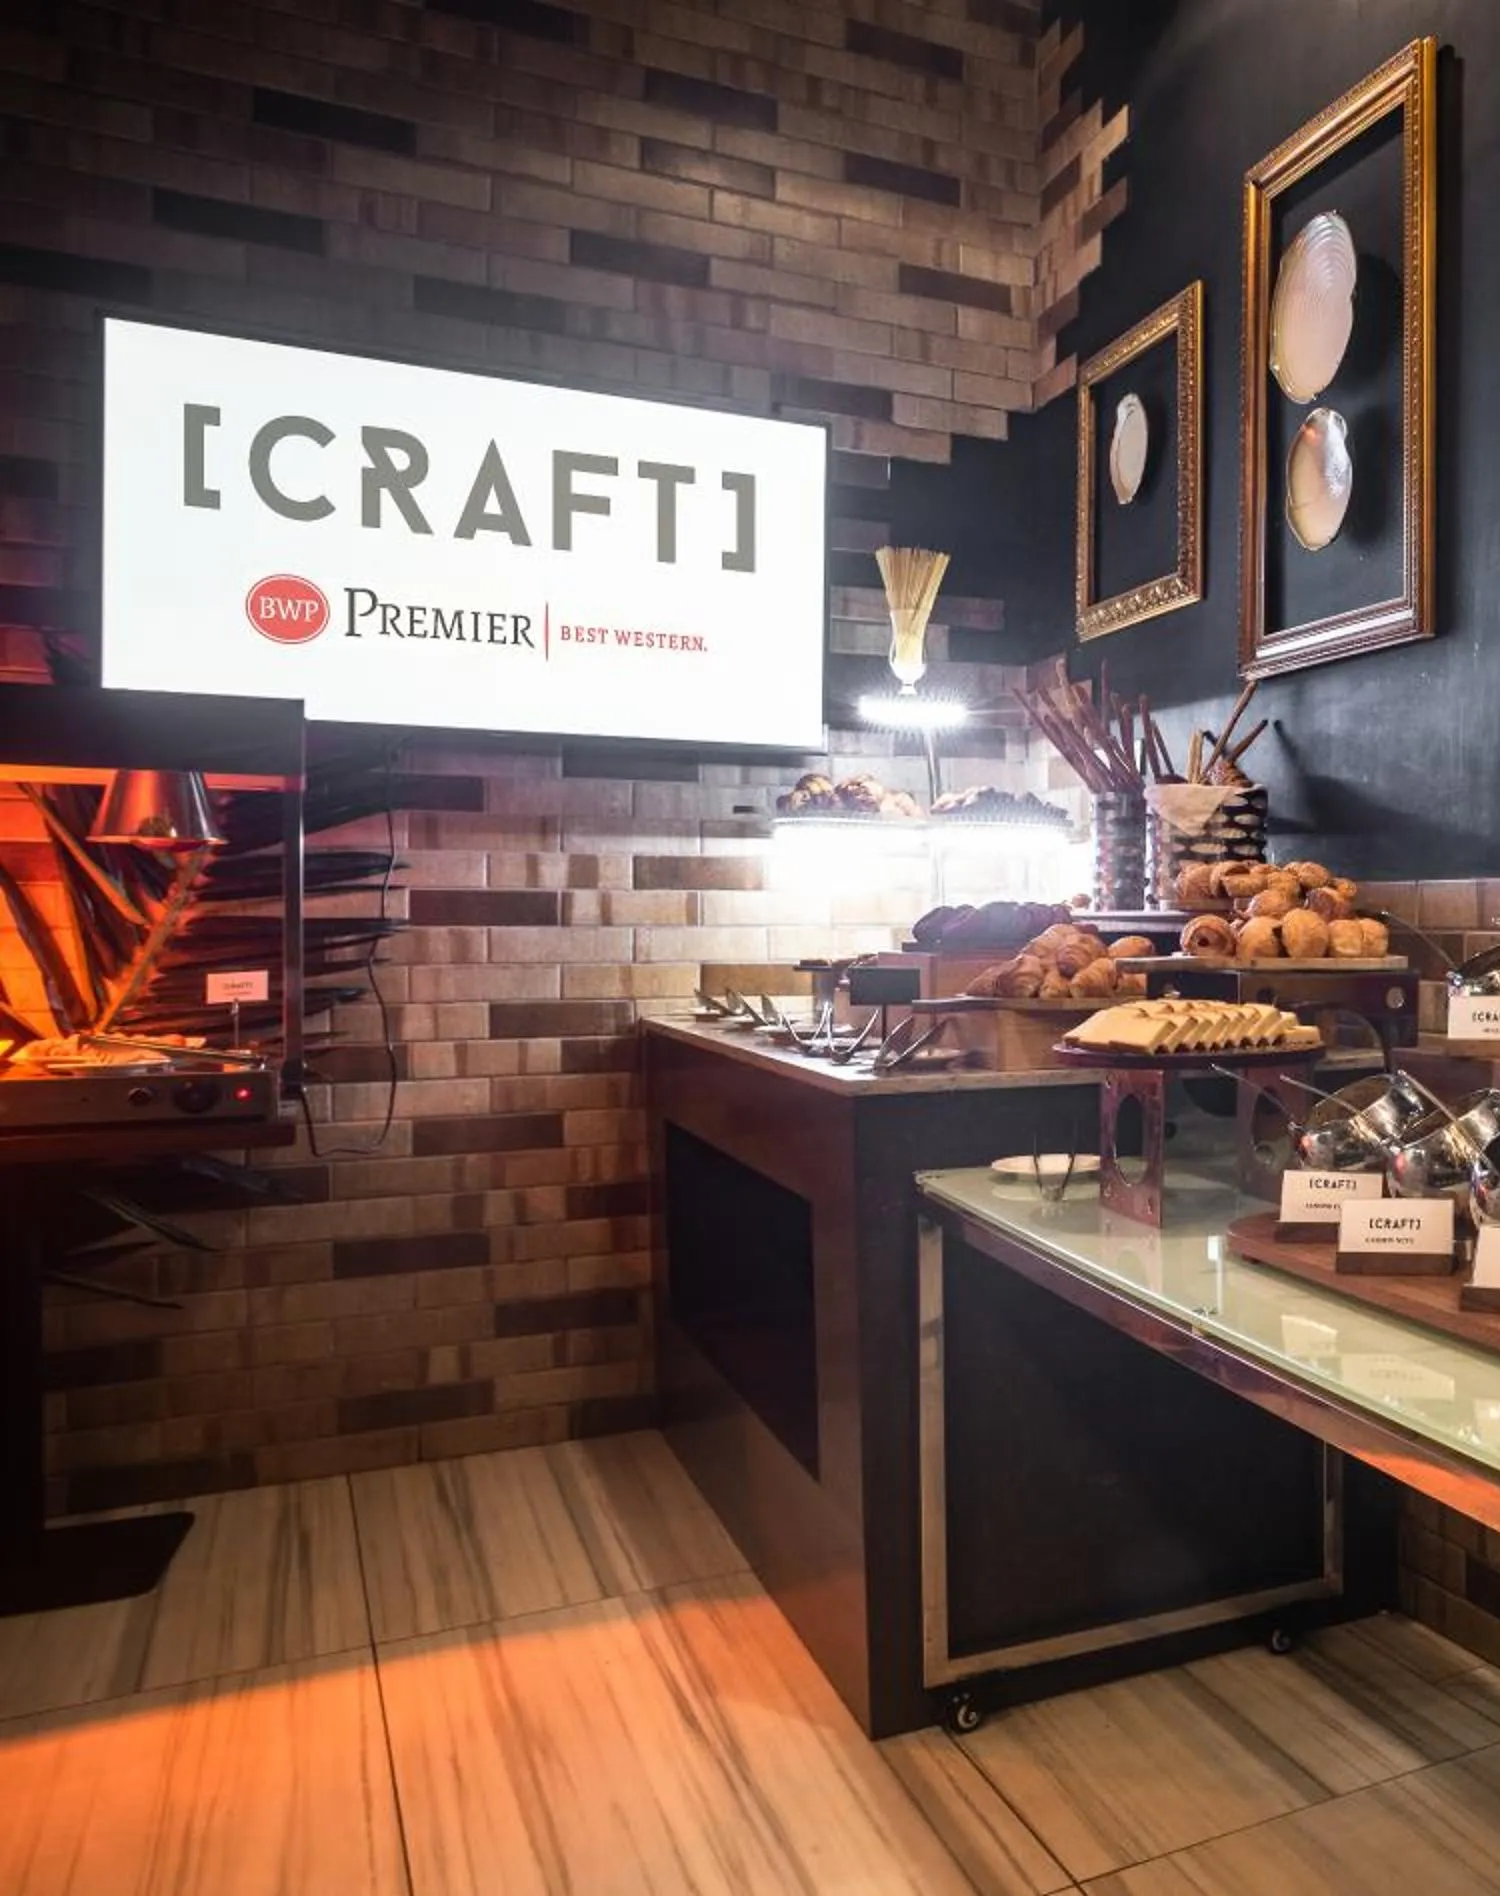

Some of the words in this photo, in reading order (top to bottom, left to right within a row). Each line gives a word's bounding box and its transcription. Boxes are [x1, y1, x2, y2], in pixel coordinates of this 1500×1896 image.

[258, 595, 320, 622] BWP
[343, 587, 536, 648] PREMIER
[560, 625, 608, 644] BEST
